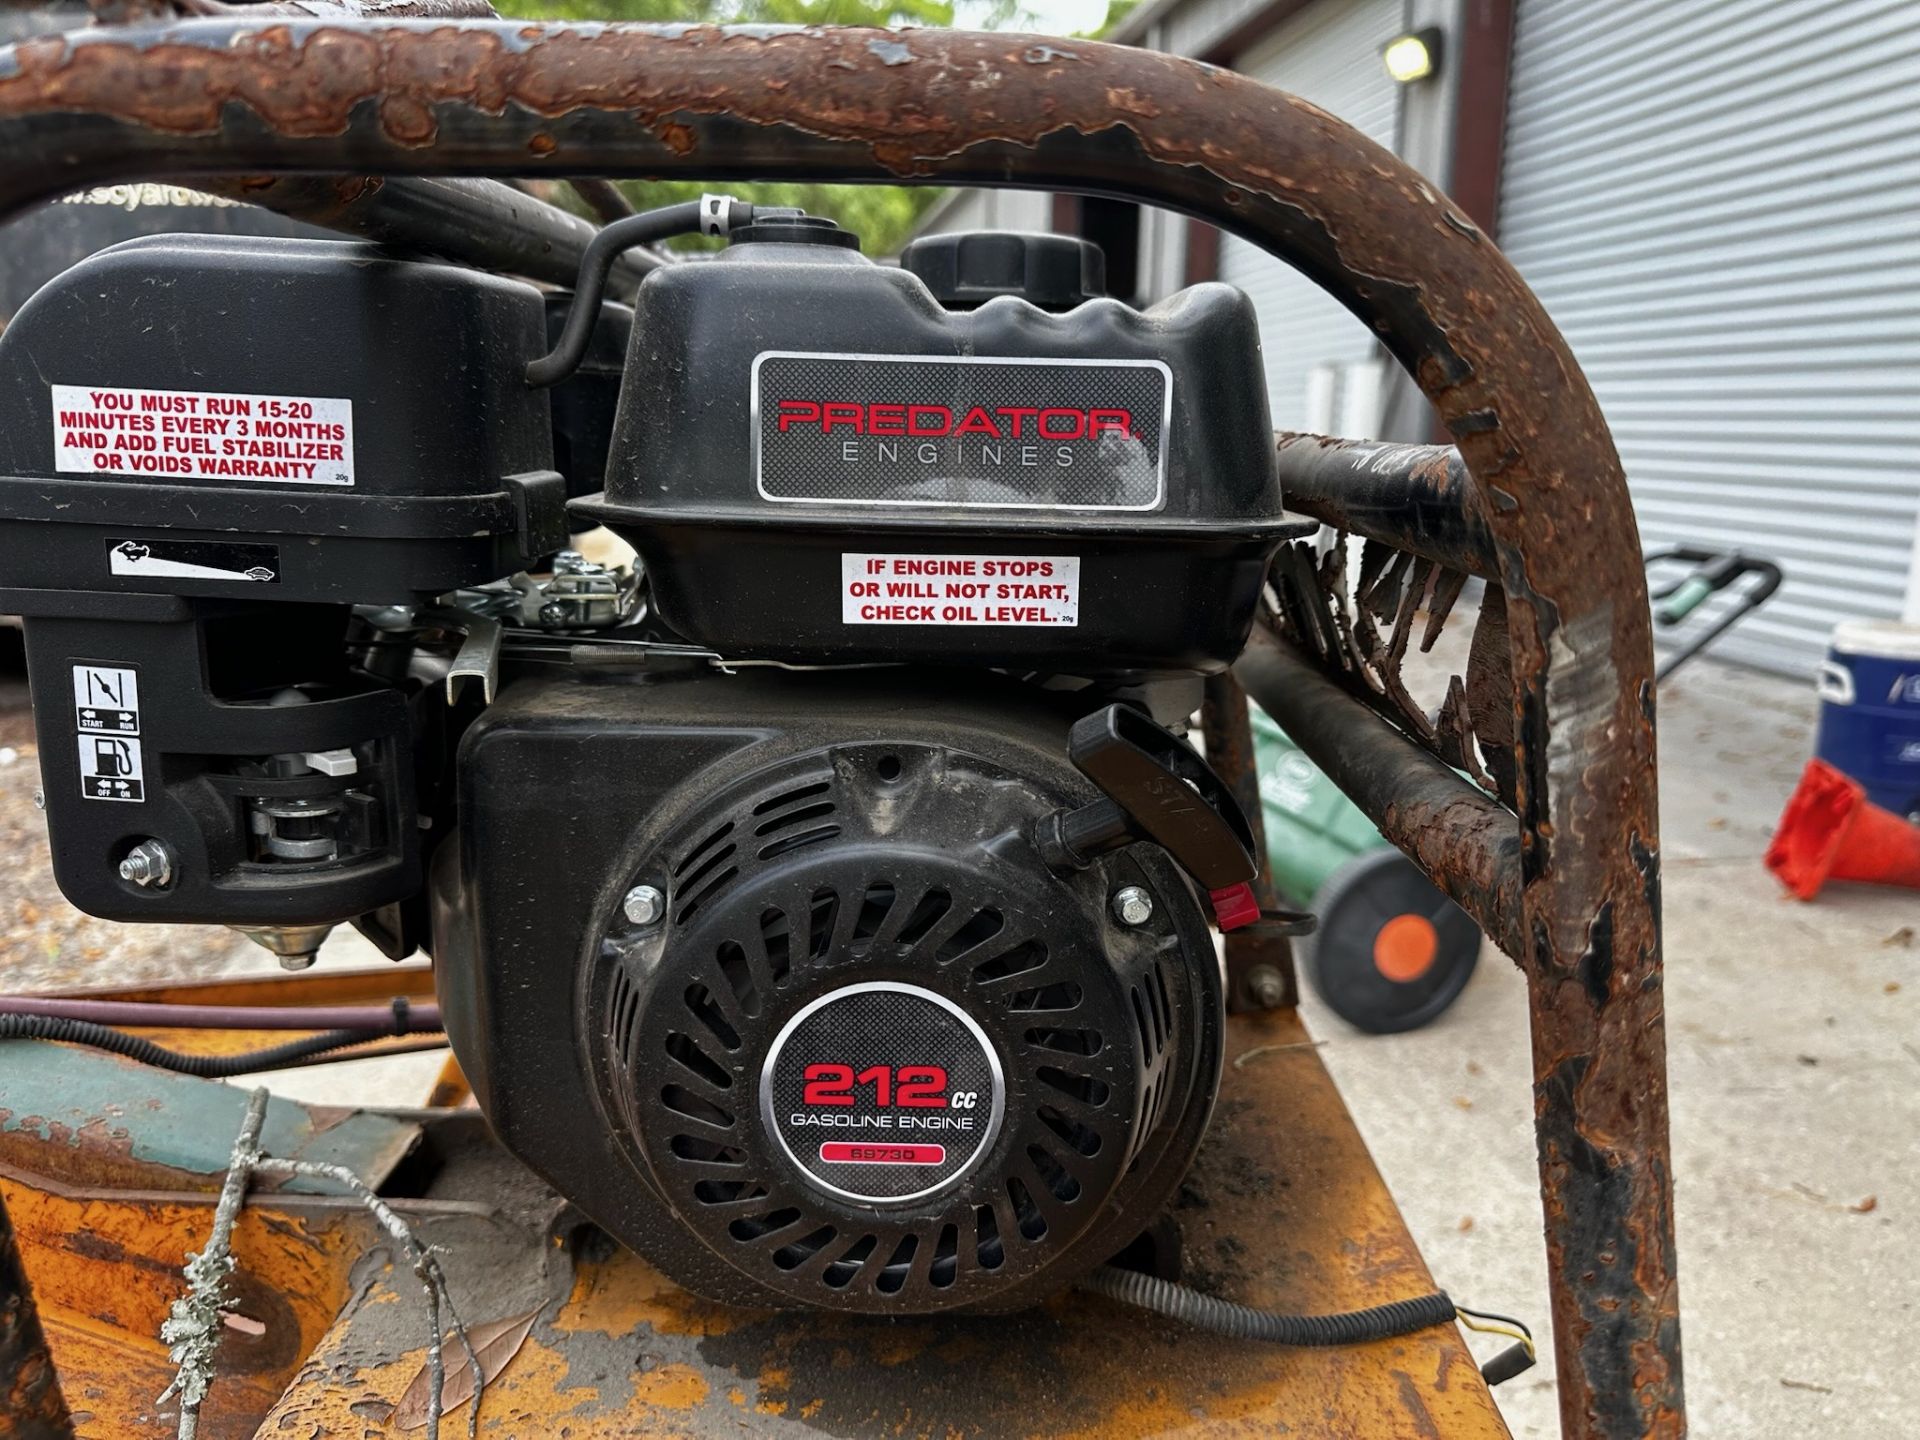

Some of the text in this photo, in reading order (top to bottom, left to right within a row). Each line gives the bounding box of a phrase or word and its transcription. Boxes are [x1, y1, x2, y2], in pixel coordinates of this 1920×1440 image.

[90, 392, 312, 419] YOU MUST RUN 15-20
[60, 412, 345, 440] MINUTES EVERY 3 MONTHS
[778, 400, 1132, 441] PREDATOR
[64, 433, 344, 460] AND ADD FUEL STABILIZER
[842, 441, 1074, 467] ENGINES
[93, 453, 349, 482] OR VOIDS WARRANTY 20g
[867, 560, 1054, 577] IF ENGINE STOPS
[850, 583, 1070, 603] OR WILL NOT START,
[861, 606, 1074, 623] CHECK OIL LEVEL. 20g
[82, 720, 134, 730] START RUN
[98, 789, 110, 797] OFF
[803, 1063, 948, 1108] 212
[790, 1114, 973, 1130] GASOLINE ENGINE
[851, 1149, 915, 1160] 69730
